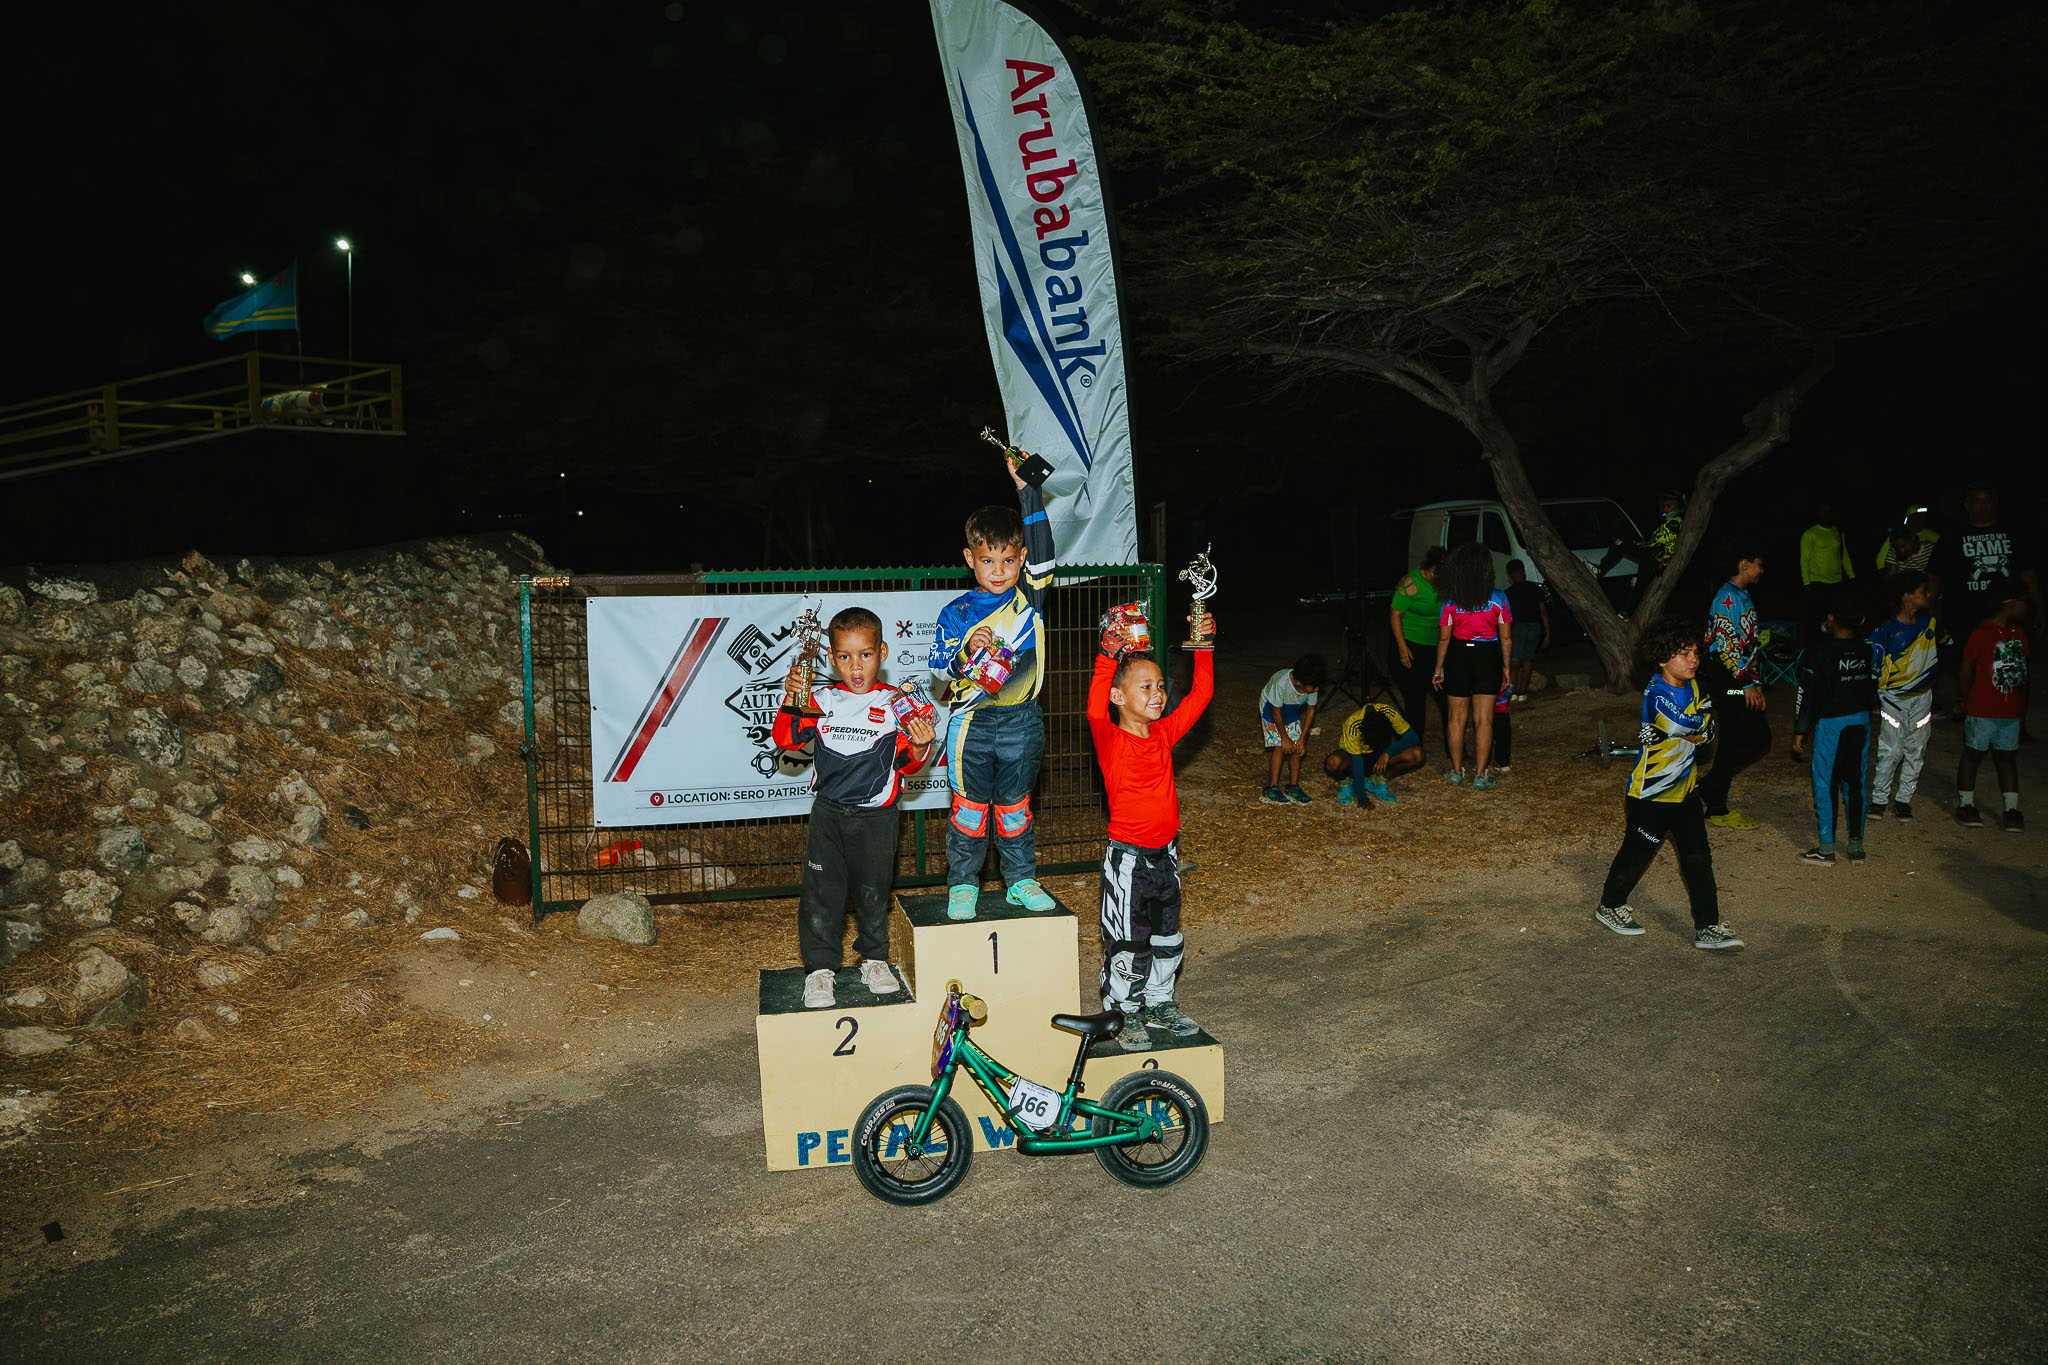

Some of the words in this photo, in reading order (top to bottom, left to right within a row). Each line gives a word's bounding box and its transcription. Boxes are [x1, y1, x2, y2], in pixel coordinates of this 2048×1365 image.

[1005, 58, 1106, 382] Arubabank
[1966, 533, 1996, 542] PAUSED
[1962, 540, 2013, 557] GAME
[1966, 581, 1979, 591] TO
[1839, 658, 1866, 670] NCA
[821, 724, 880, 737] SPEEDWORX
[667, 791, 731, 804] LOCATION:
[733, 789, 765, 800] SERO
[987, 931, 999, 974] 1
[832, 1016, 859, 1057] 2
[1020, 1091, 1049, 1117] 166
[797, 1124, 948, 1166] PEAL
